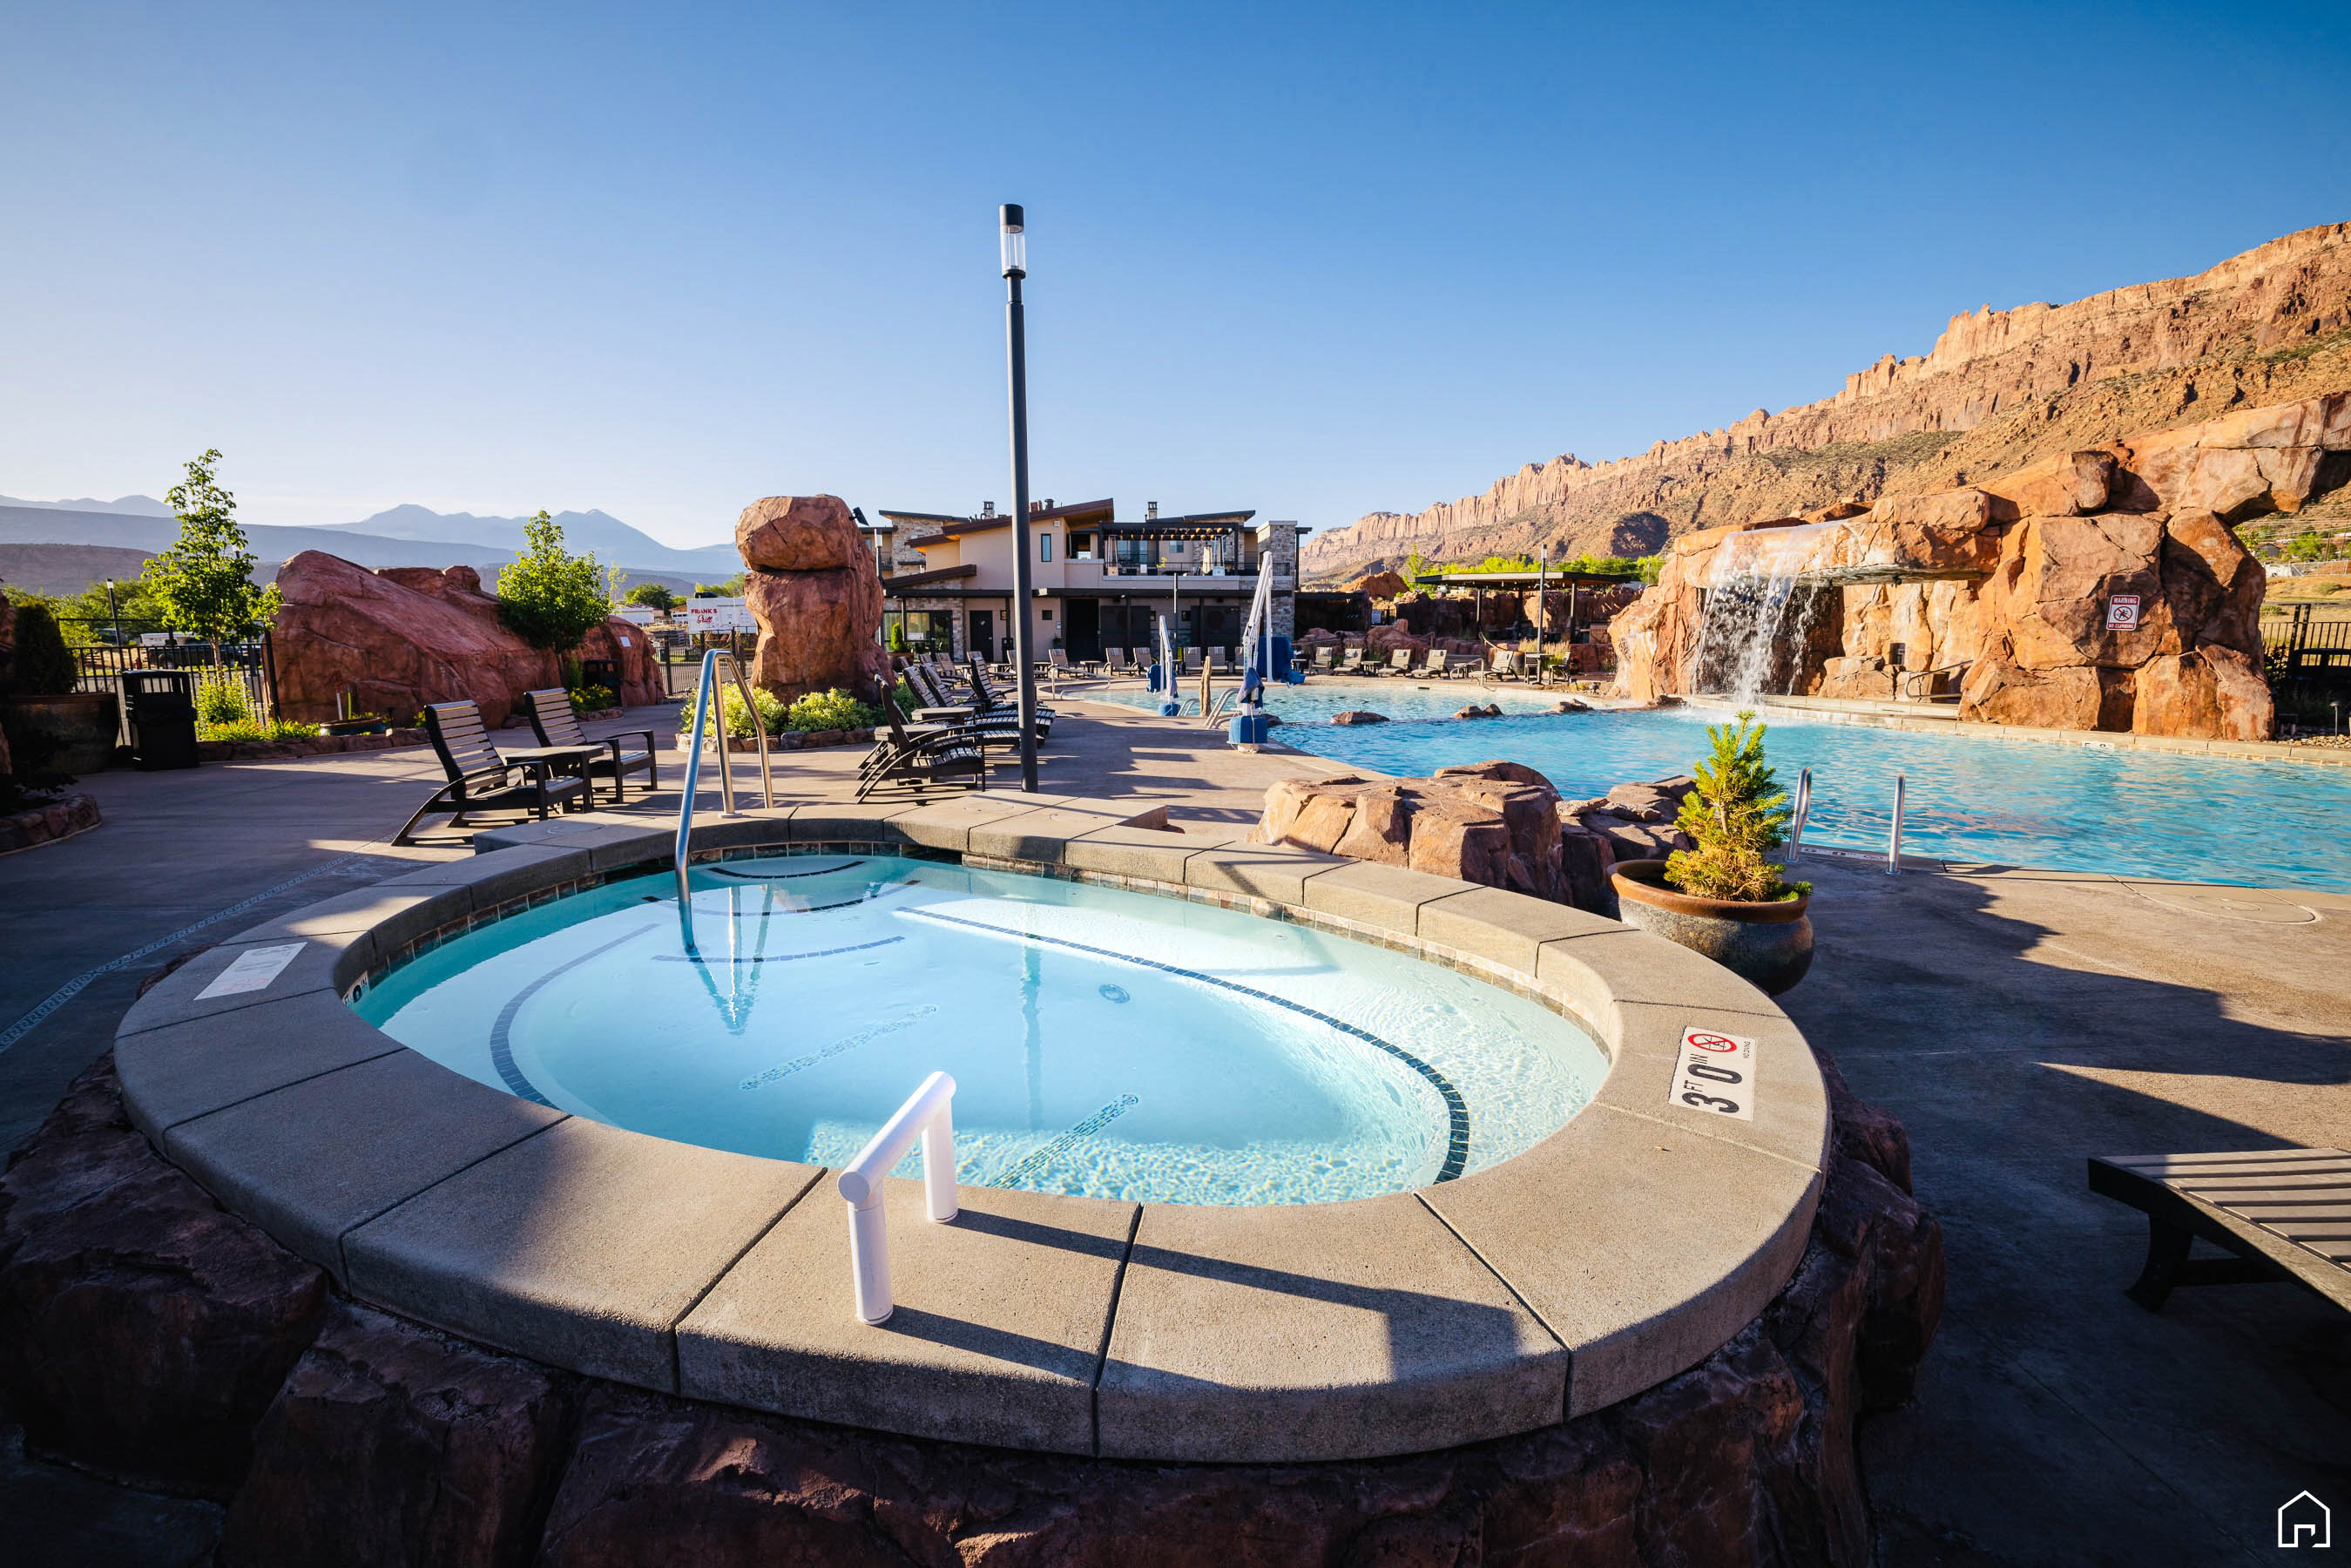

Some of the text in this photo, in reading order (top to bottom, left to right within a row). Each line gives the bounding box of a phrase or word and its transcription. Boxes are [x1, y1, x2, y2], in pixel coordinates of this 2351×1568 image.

[1681, 1053, 1742, 1113] 3 FT 0 IN
